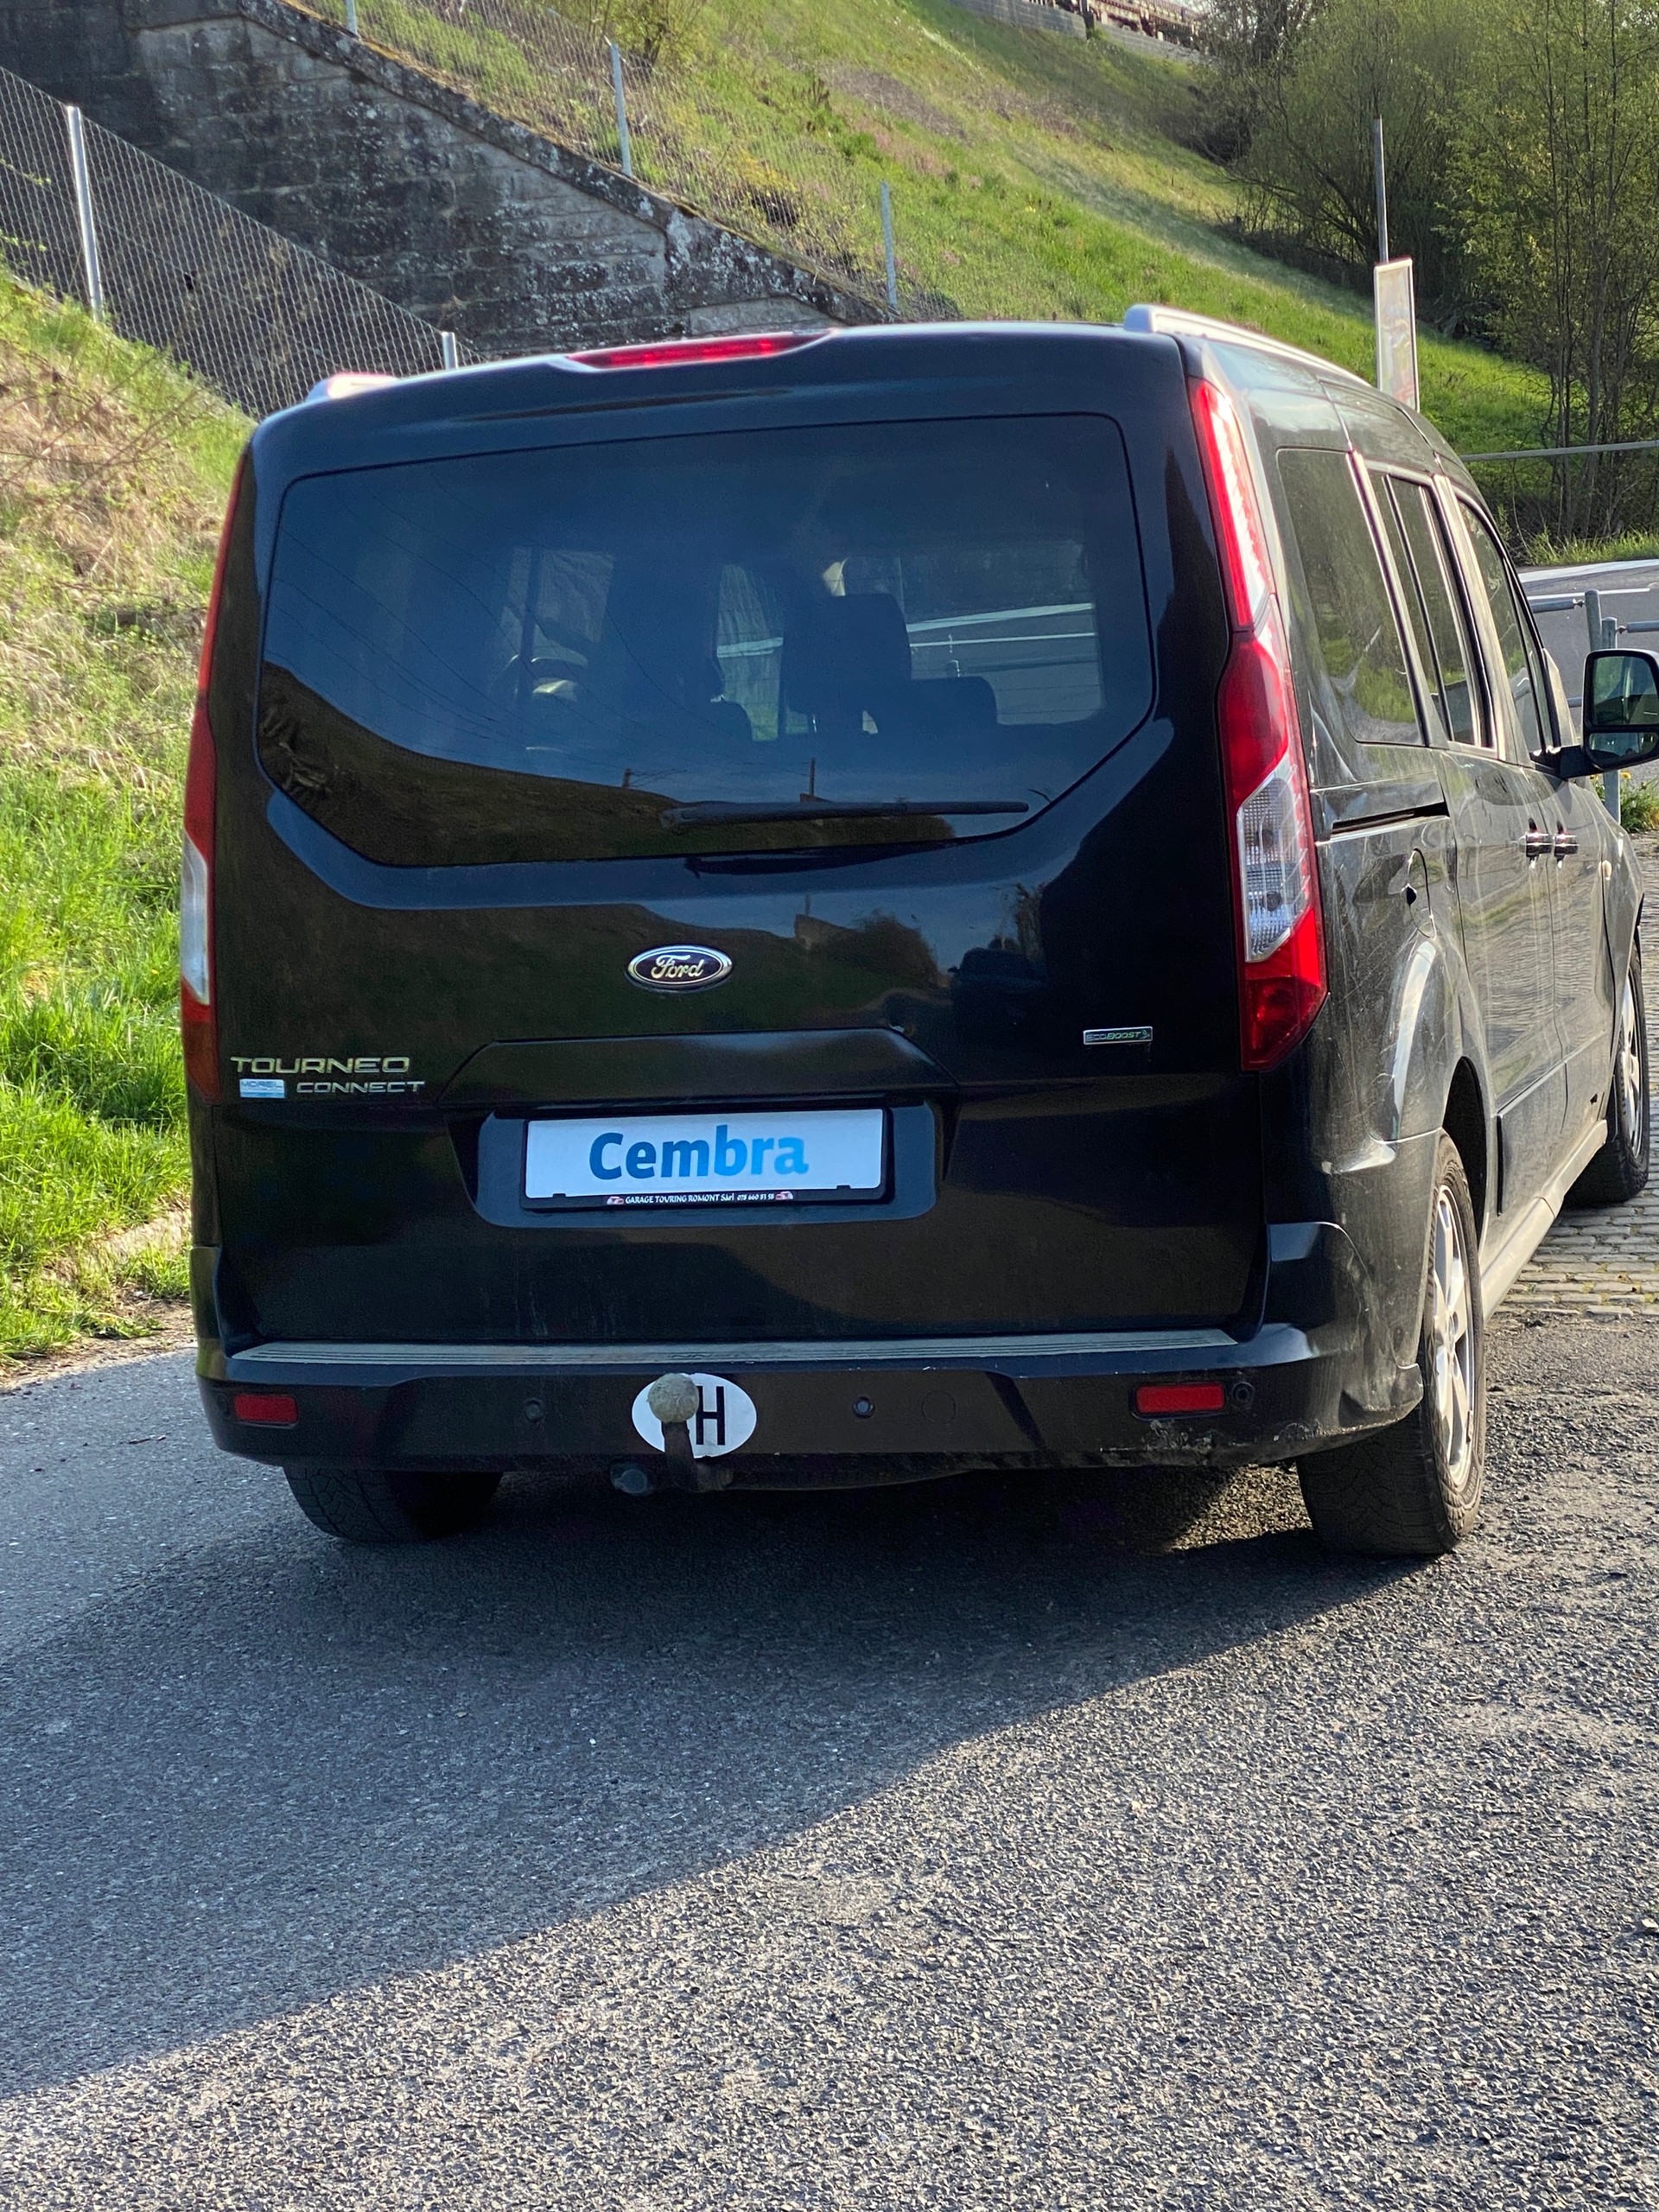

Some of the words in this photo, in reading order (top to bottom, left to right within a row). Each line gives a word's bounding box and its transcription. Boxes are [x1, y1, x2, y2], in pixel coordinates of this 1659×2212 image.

[651, 954, 705, 979] Ford
[230, 1057, 410, 1073] TOURNEO
[296, 1081, 425, 1093] CONNECT
[588, 1124, 810, 1180] Cembra
[688, 1193, 720, 1202] ROMONT
